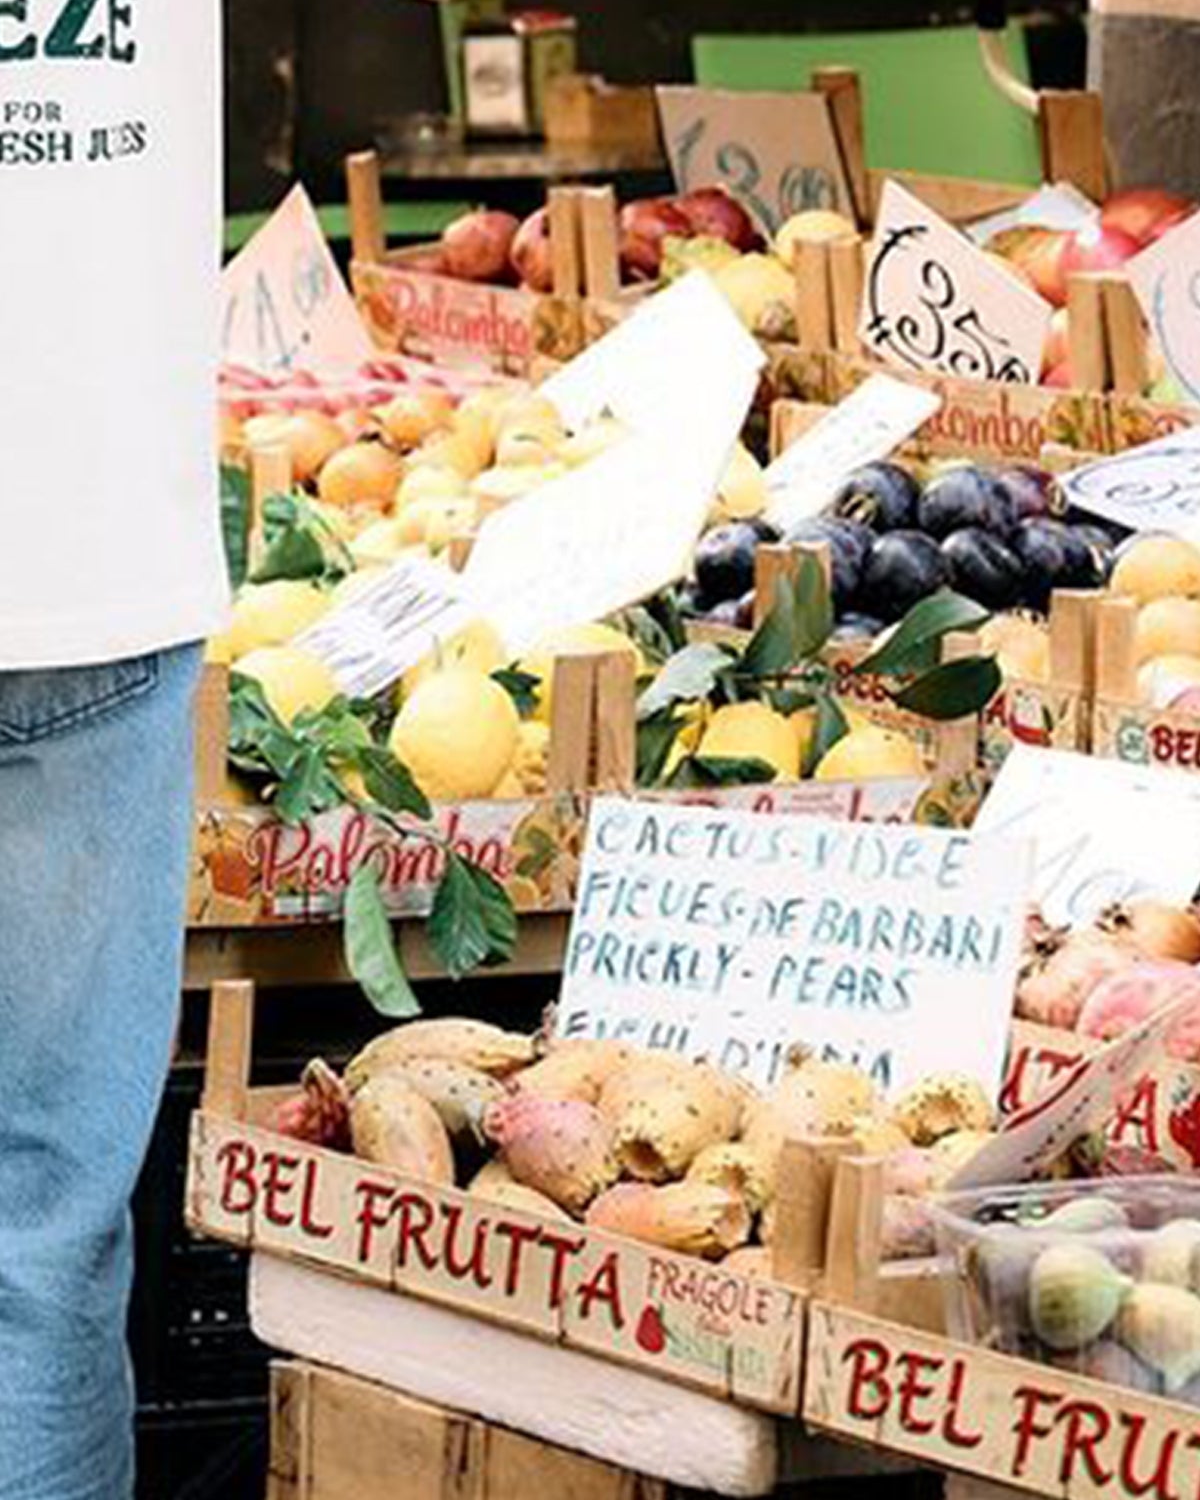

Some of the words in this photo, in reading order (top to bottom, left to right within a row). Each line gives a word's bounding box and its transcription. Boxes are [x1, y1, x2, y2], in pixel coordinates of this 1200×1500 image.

[3, 100, 62, 124] FOR
[386, 276, 531, 356] Palomba
[216, 1139, 333, 1239] BEL
[354, 1179, 627, 1331] FRUTTA
[647, 1256, 773, 1326] FRAGOLE
[842, 1338, 983, 1449] BEL
[1011, 1385, 1200, 1500] FRU
